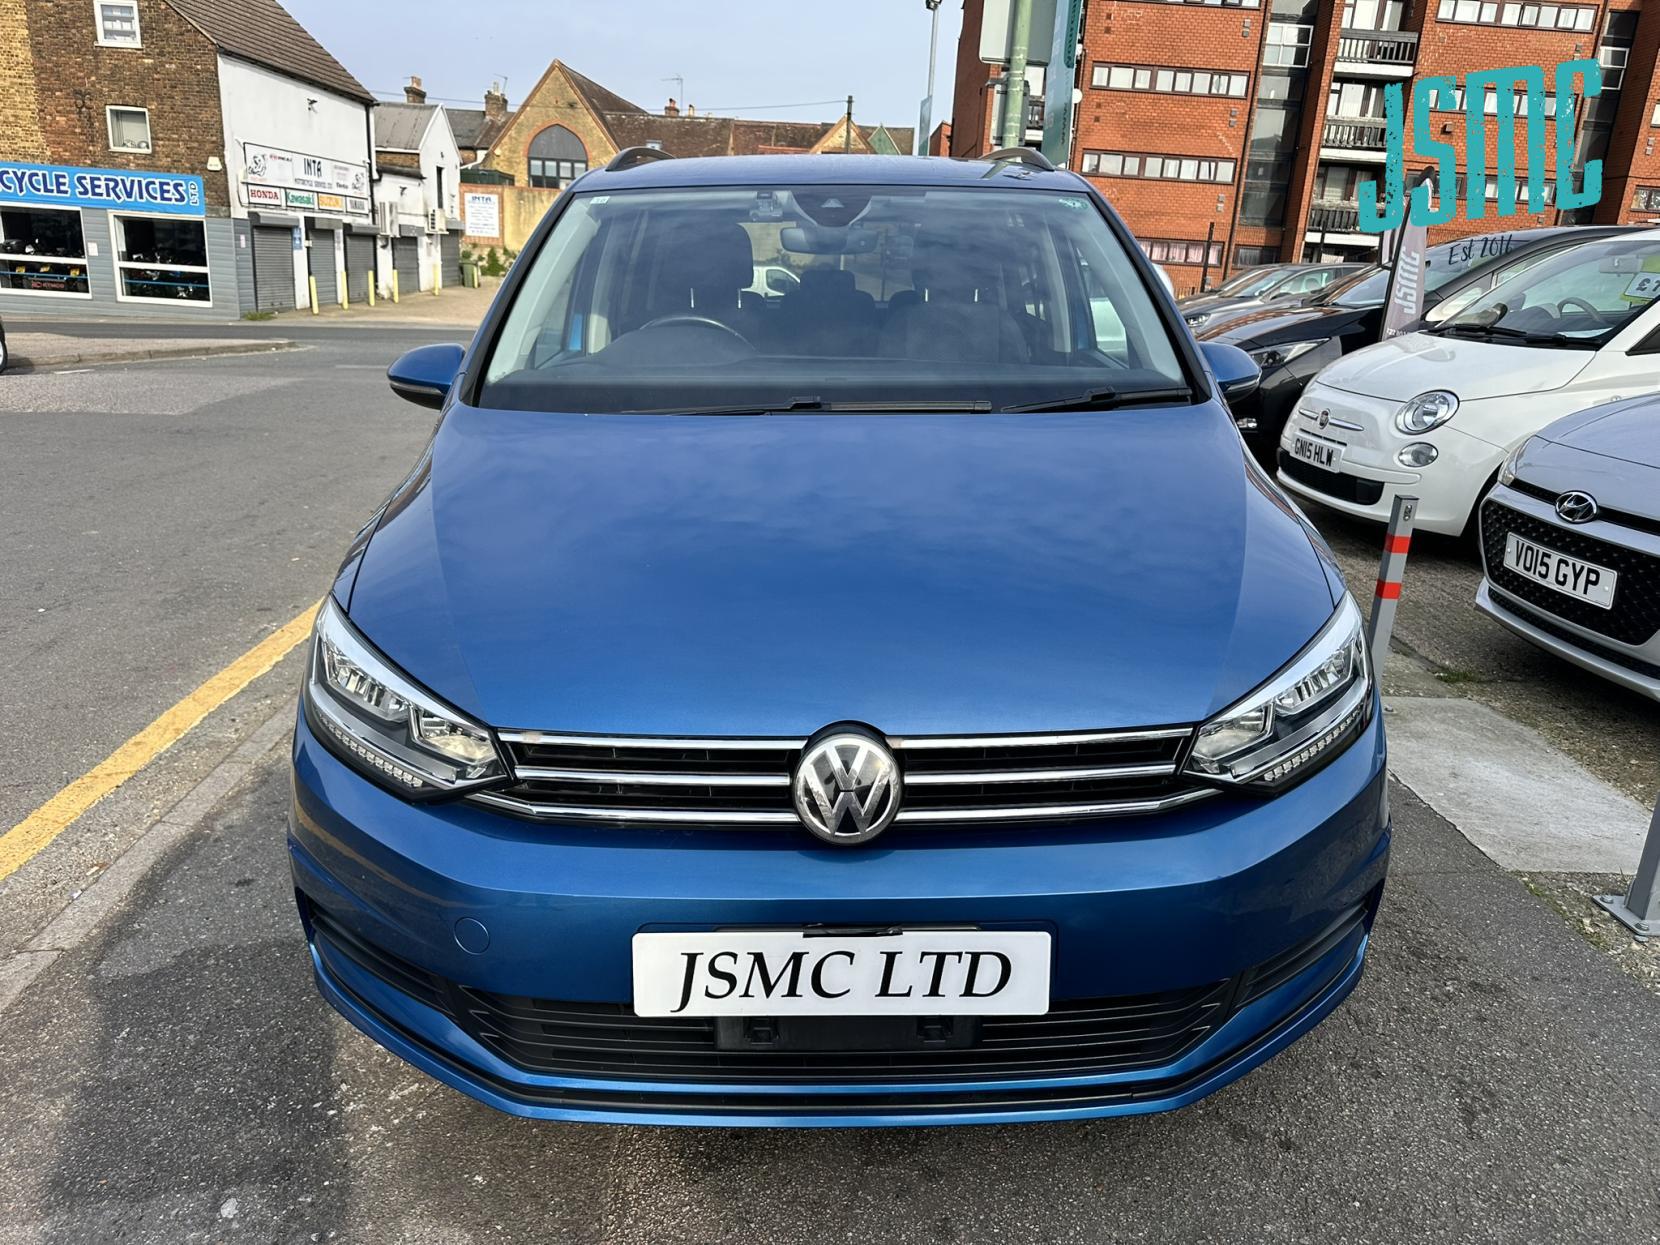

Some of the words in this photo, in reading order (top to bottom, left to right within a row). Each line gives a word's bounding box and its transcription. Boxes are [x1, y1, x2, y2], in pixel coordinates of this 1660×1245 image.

[303, 157, 322, 178] INTA
[0, 169, 70, 195] CYCLE
[75, 174, 186, 203] SERVICES
[189, 181, 199, 205] LTD
[250, 189, 279, 200] HONDA
[1394, 246, 1420, 314] JSMC
[1294, 438, 1314, 459] GN15
[1313, 445, 1334, 466] HLW
[1555, 558, 1600, 595] GYP
[799, 738, 899, 841] VW
[670, 951, 855, 1013] JSMC
[875, 951, 1013, 999] LTD
